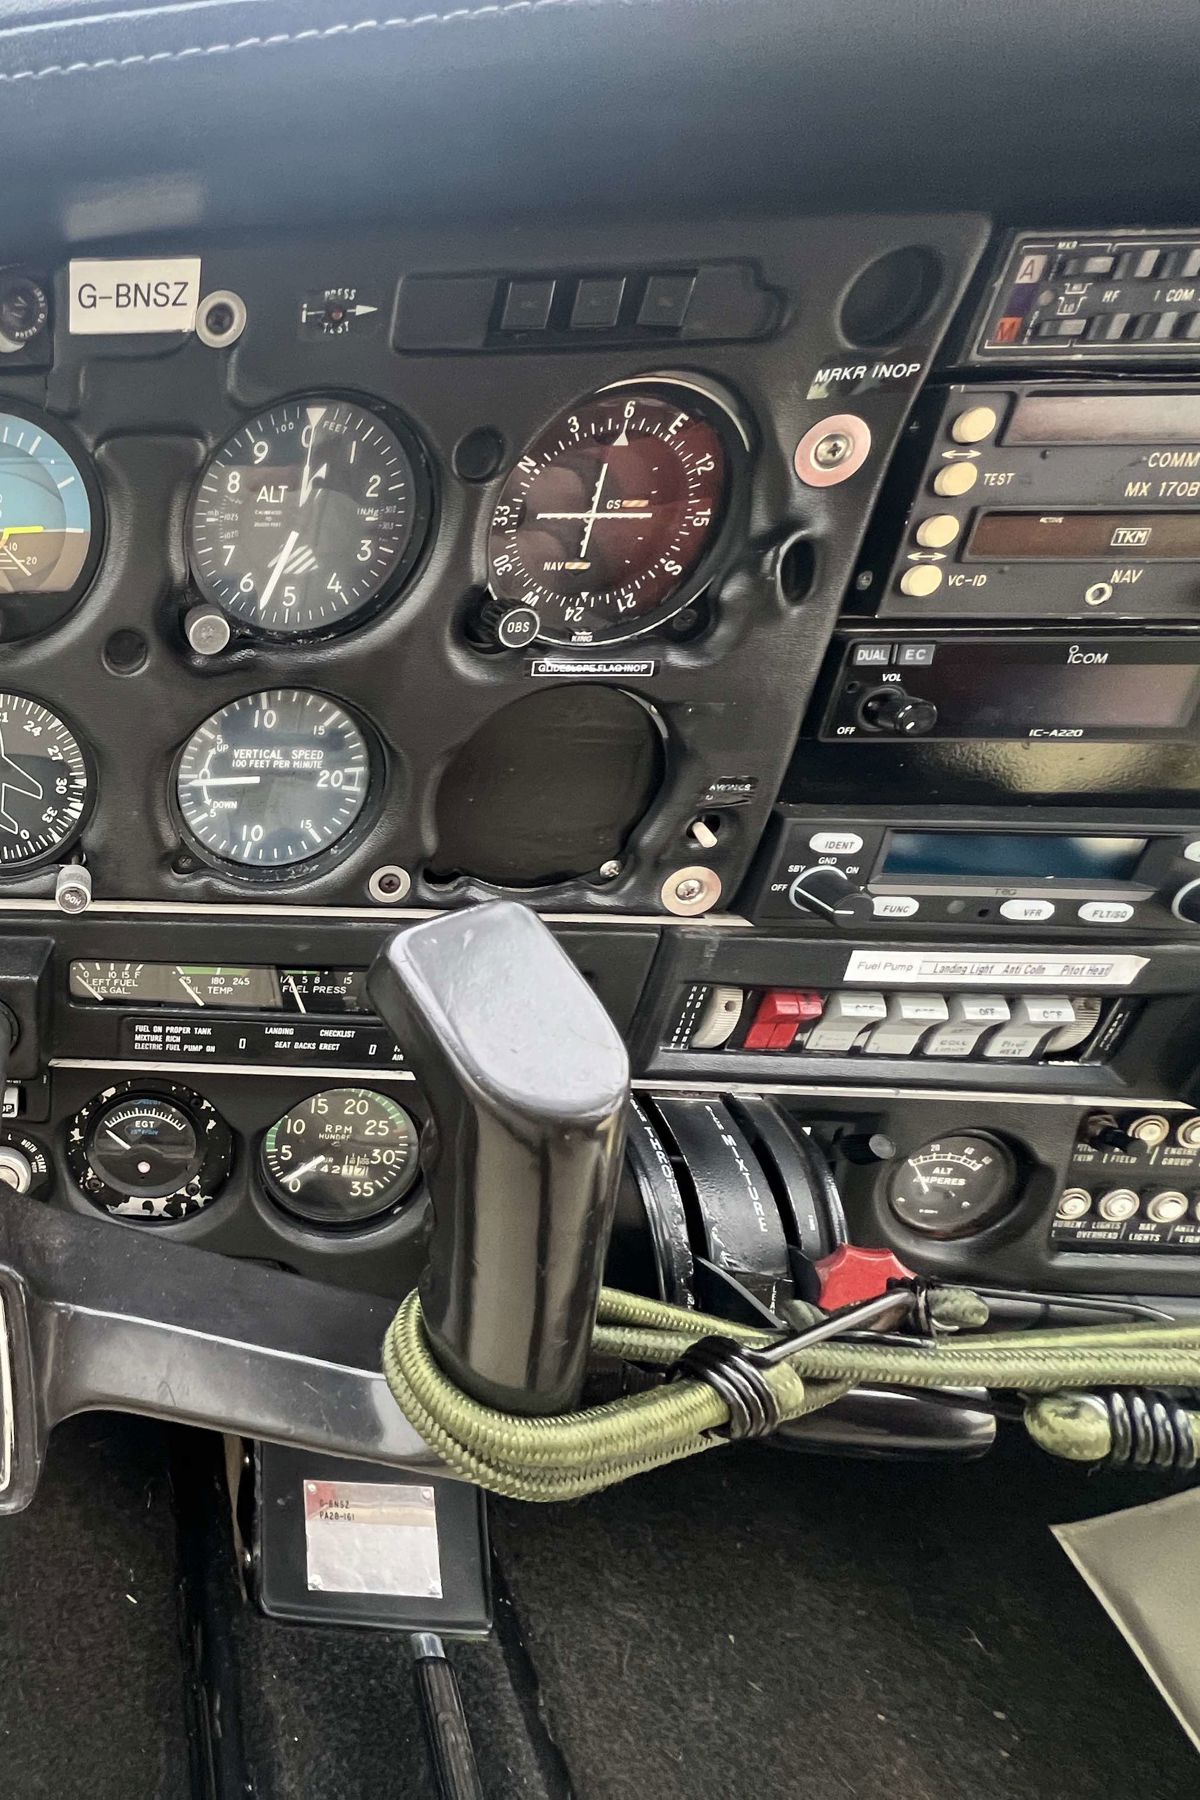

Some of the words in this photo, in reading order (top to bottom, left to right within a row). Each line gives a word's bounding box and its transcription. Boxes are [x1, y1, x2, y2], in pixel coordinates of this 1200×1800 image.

[1019, 260, 1035, 280] A
[78, 282, 189, 309] G-BNSZ
[815, 366, 866, 383] MRKR
[872, 363, 920, 378] INOP
[624, 401, 635, 418] 6
[323, 421, 348, 434] FEET
[254, 441, 268, 464] 9
[1148, 452, 1200, 467] COMM
[227, 472, 240, 493] 8
[366, 475, 381, 497] 2
[983, 473, 1015, 485] TEST
[256, 485, 288, 503] ALT
[1124, 482, 1152, 496] MX
[1159, 482, 1200, 496] 170B
[607, 499, 621, 510] GS
[692, 508, 712, 528] 15
[1117, 531, 1147, 543] TKM
[223, 545, 235, 565] 7
[357, 540, 372, 561] 3
[543, 561, 564, 571] NAV
[240, 572, 254, 592] 6
[327, 573, 341, 593] 4
[948, 575, 987, 586] VC-ID
[1110, 570, 1143, 583] NAV
[283, 587, 296, 606] 5
[617, 593, 636, 612] 21
[507, 621, 530, 633] OBS
[857, 650, 887, 661] DUAL
[882, 673, 902, 682] VOL
[254, 710, 277, 728] 10
[23, 721, 43, 737] 24
[313, 726, 325, 735] 15
[836, 726, 856, 735] OFF
[1029, 729, 1084, 737] IC-A220
[47, 746, 63, 761] 27
[217, 745, 229, 753] UP
[234, 750, 283, 759] VERTICAL
[292, 750, 324, 760] SPEED
[56, 778, 67, 794] 30
[317, 770, 343, 787] 20
[42, 807, 58, 824] 33
[301, 820, 312, 829] 15
[242, 825, 264, 841] 10
[825, 841, 855, 849] IDENT
[883, 905, 910, 913] FUNC
[857, 962, 880, 970] Fuel
[884, 963, 913, 972] Pump
[933, 964, 967, 975] Landing
[970, 964, 994, 975] Light
[1003, 964, 1021, 974] Anti
[1061, 965, 1084, 975] Pitot
[1086, 965, 1111, 976] Heat
[114, 979, 138, 987] FUEL
[313, 986, 346, 994] PRESS
[135, 1034, 162, 1042] MIXTURE
[265, 1027, 294, 1035] LANDING
[320, 1030, 355, 1038] CHECKLIST
[311, 1099, 328, 1114] 15
[344, 1099, 368, 1115] 20
[287, 1119, 305, 1134] 10
[364, 1120, 389, 1136] 25
[281, 1145, 293, 1160] 5
[370, 1149, 395, 1164] 30
[35, 1154, 46, 1172] START
[1162, 1158, 1193, 1166] GROUP
[350, 1181, 374, 1196] 35
[721, 1134, 769, 1232] MIXTURE
[1076, 1231, 1118, 1239] OVERHEAD
[320, 1511, 354, 1520] PA28-161
